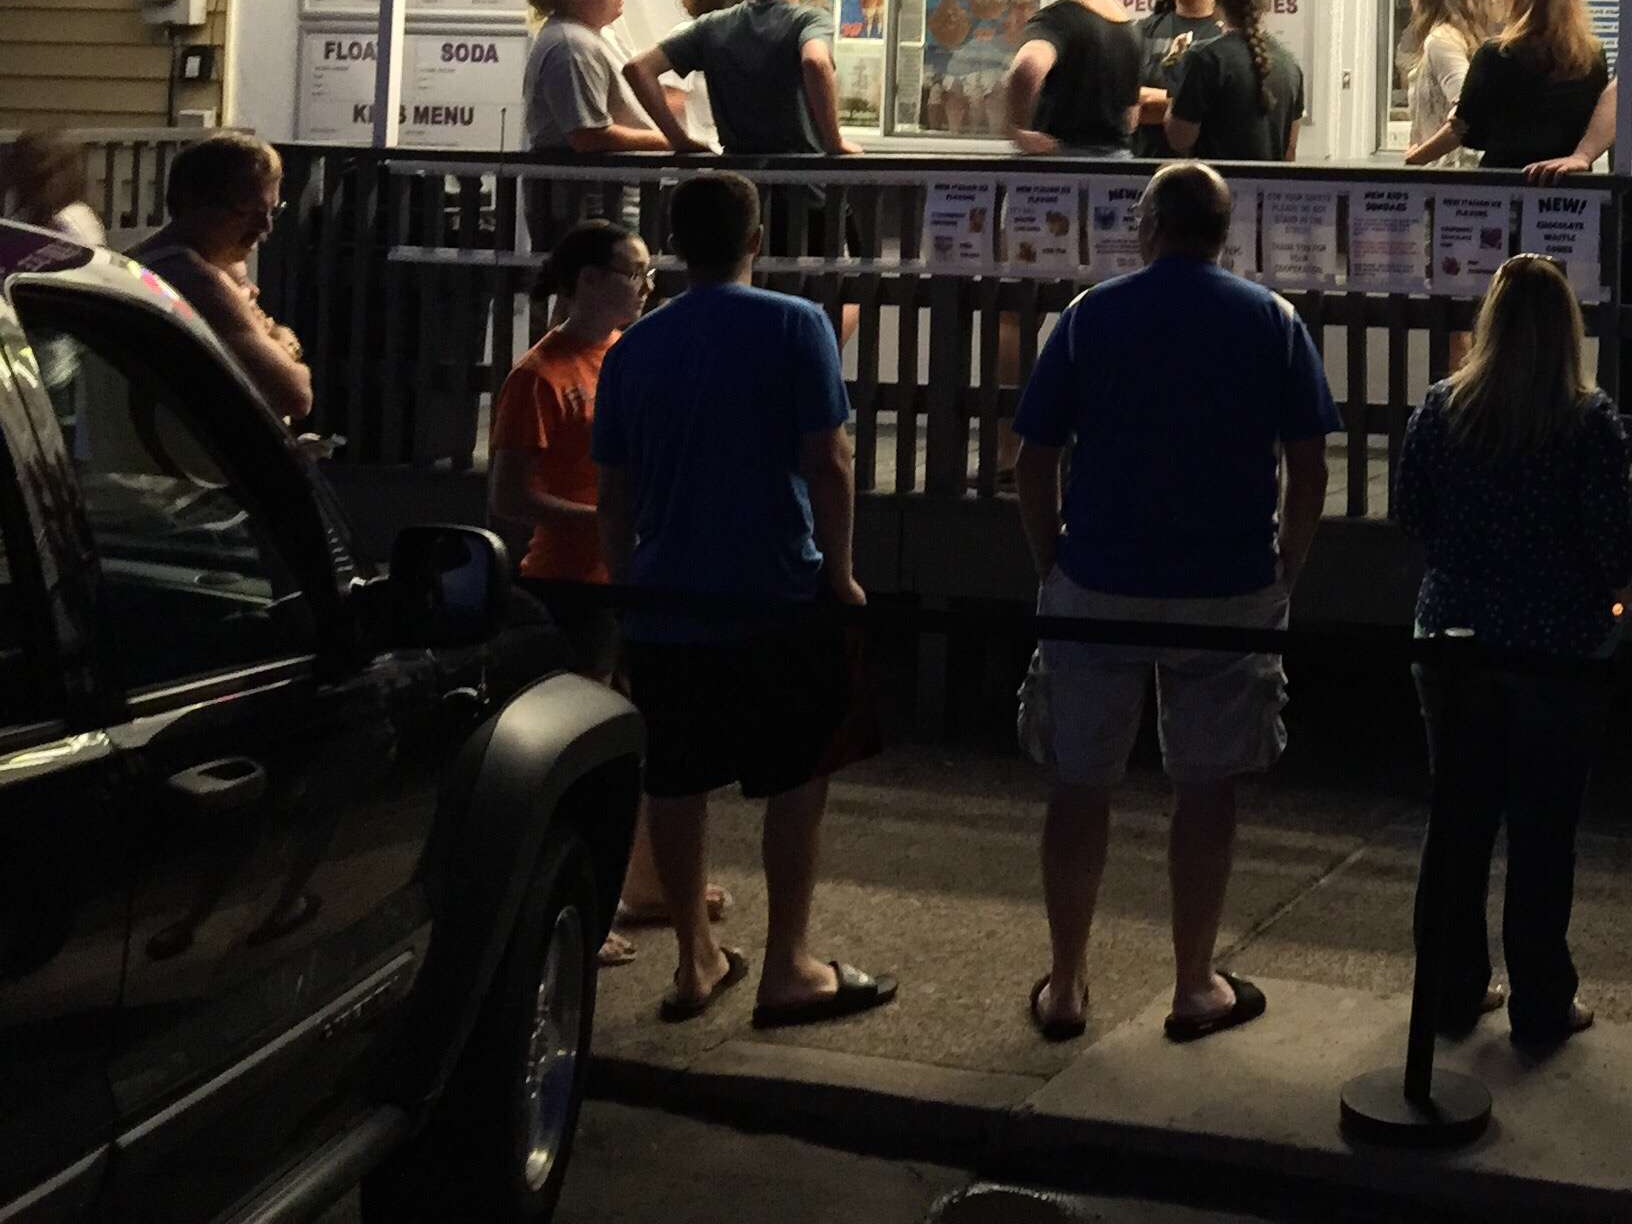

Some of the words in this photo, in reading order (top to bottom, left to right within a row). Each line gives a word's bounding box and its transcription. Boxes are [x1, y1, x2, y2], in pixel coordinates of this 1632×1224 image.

[324, 41, 378, 61] FLOA
[441, 44, 499, 63] SODA
[353, 104, 407, 125] KIS
[413, 105, 475, 126] MENU
[1538, 197, 1588, 215] NEW!
